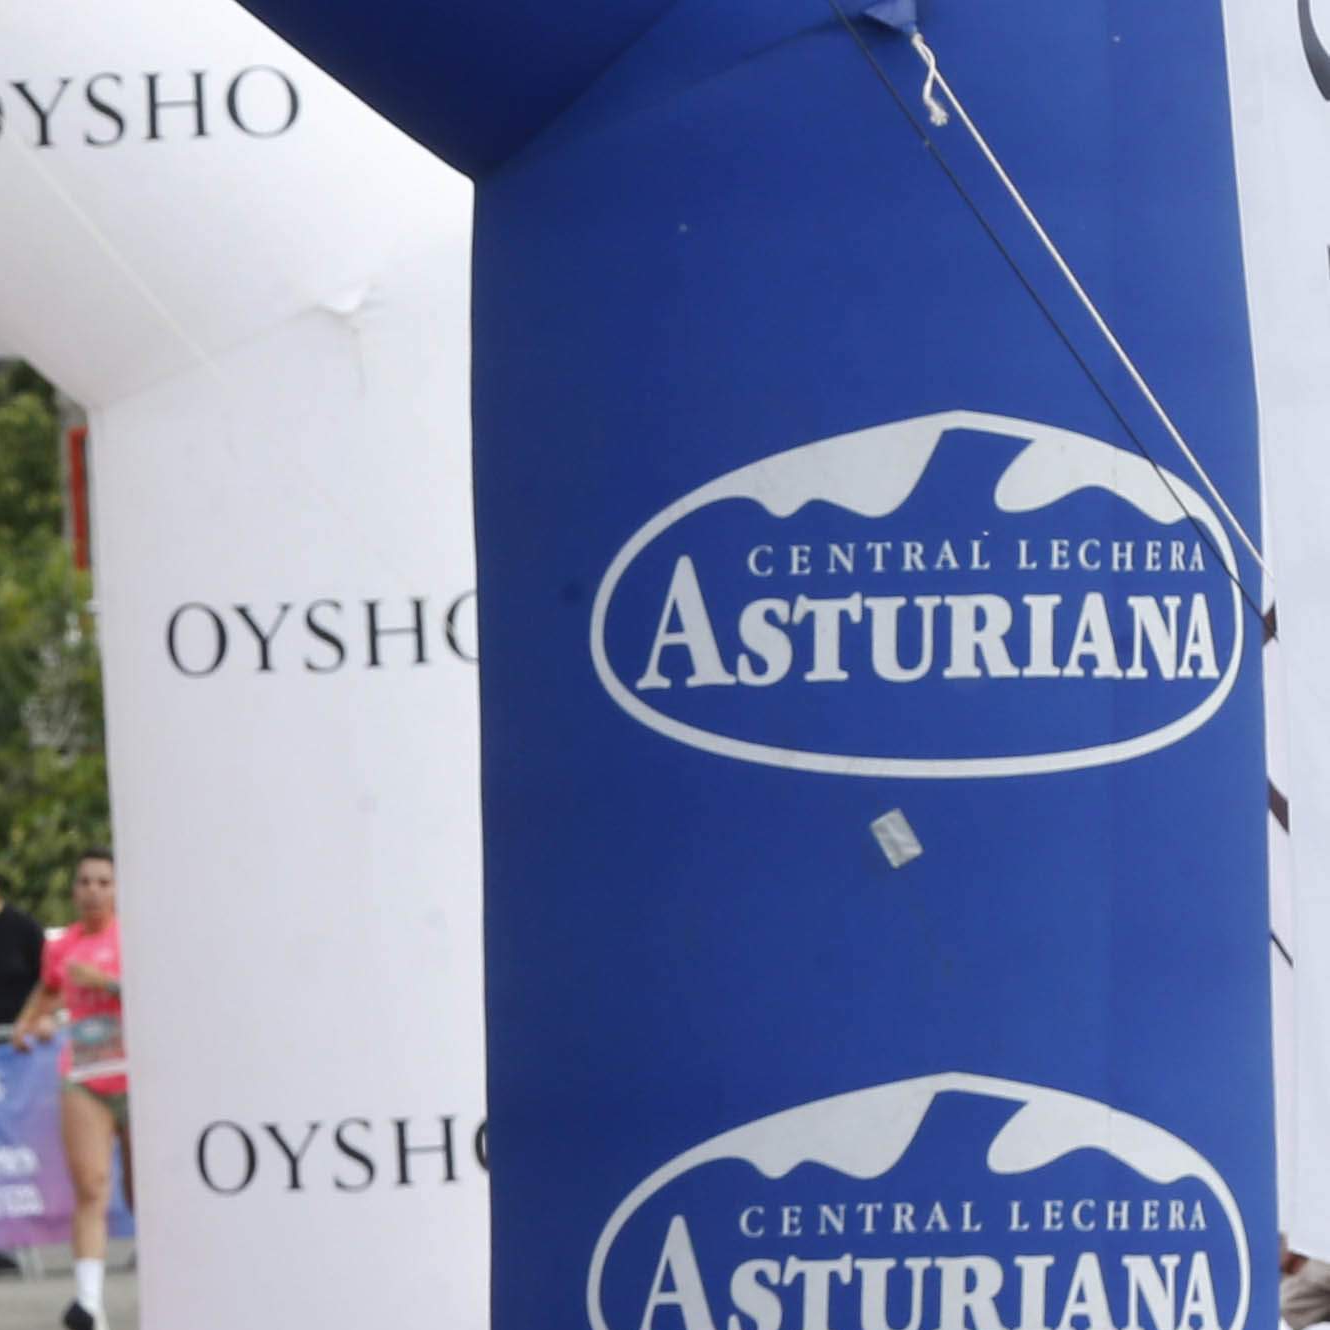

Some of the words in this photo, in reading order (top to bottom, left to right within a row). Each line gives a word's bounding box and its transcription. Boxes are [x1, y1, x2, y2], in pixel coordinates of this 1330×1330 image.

[747, 539, 991, 577] CENTRAL
[1018, 537, 1206, 573] LECHERA
[635, 554, 1221, 690] ASTURIANA
[196, 1112, 490, 1196] OYSH
[739, 1201, 983, 1238] CENTRAL
[1010, 1198, 1208, 1232] LECHERA
